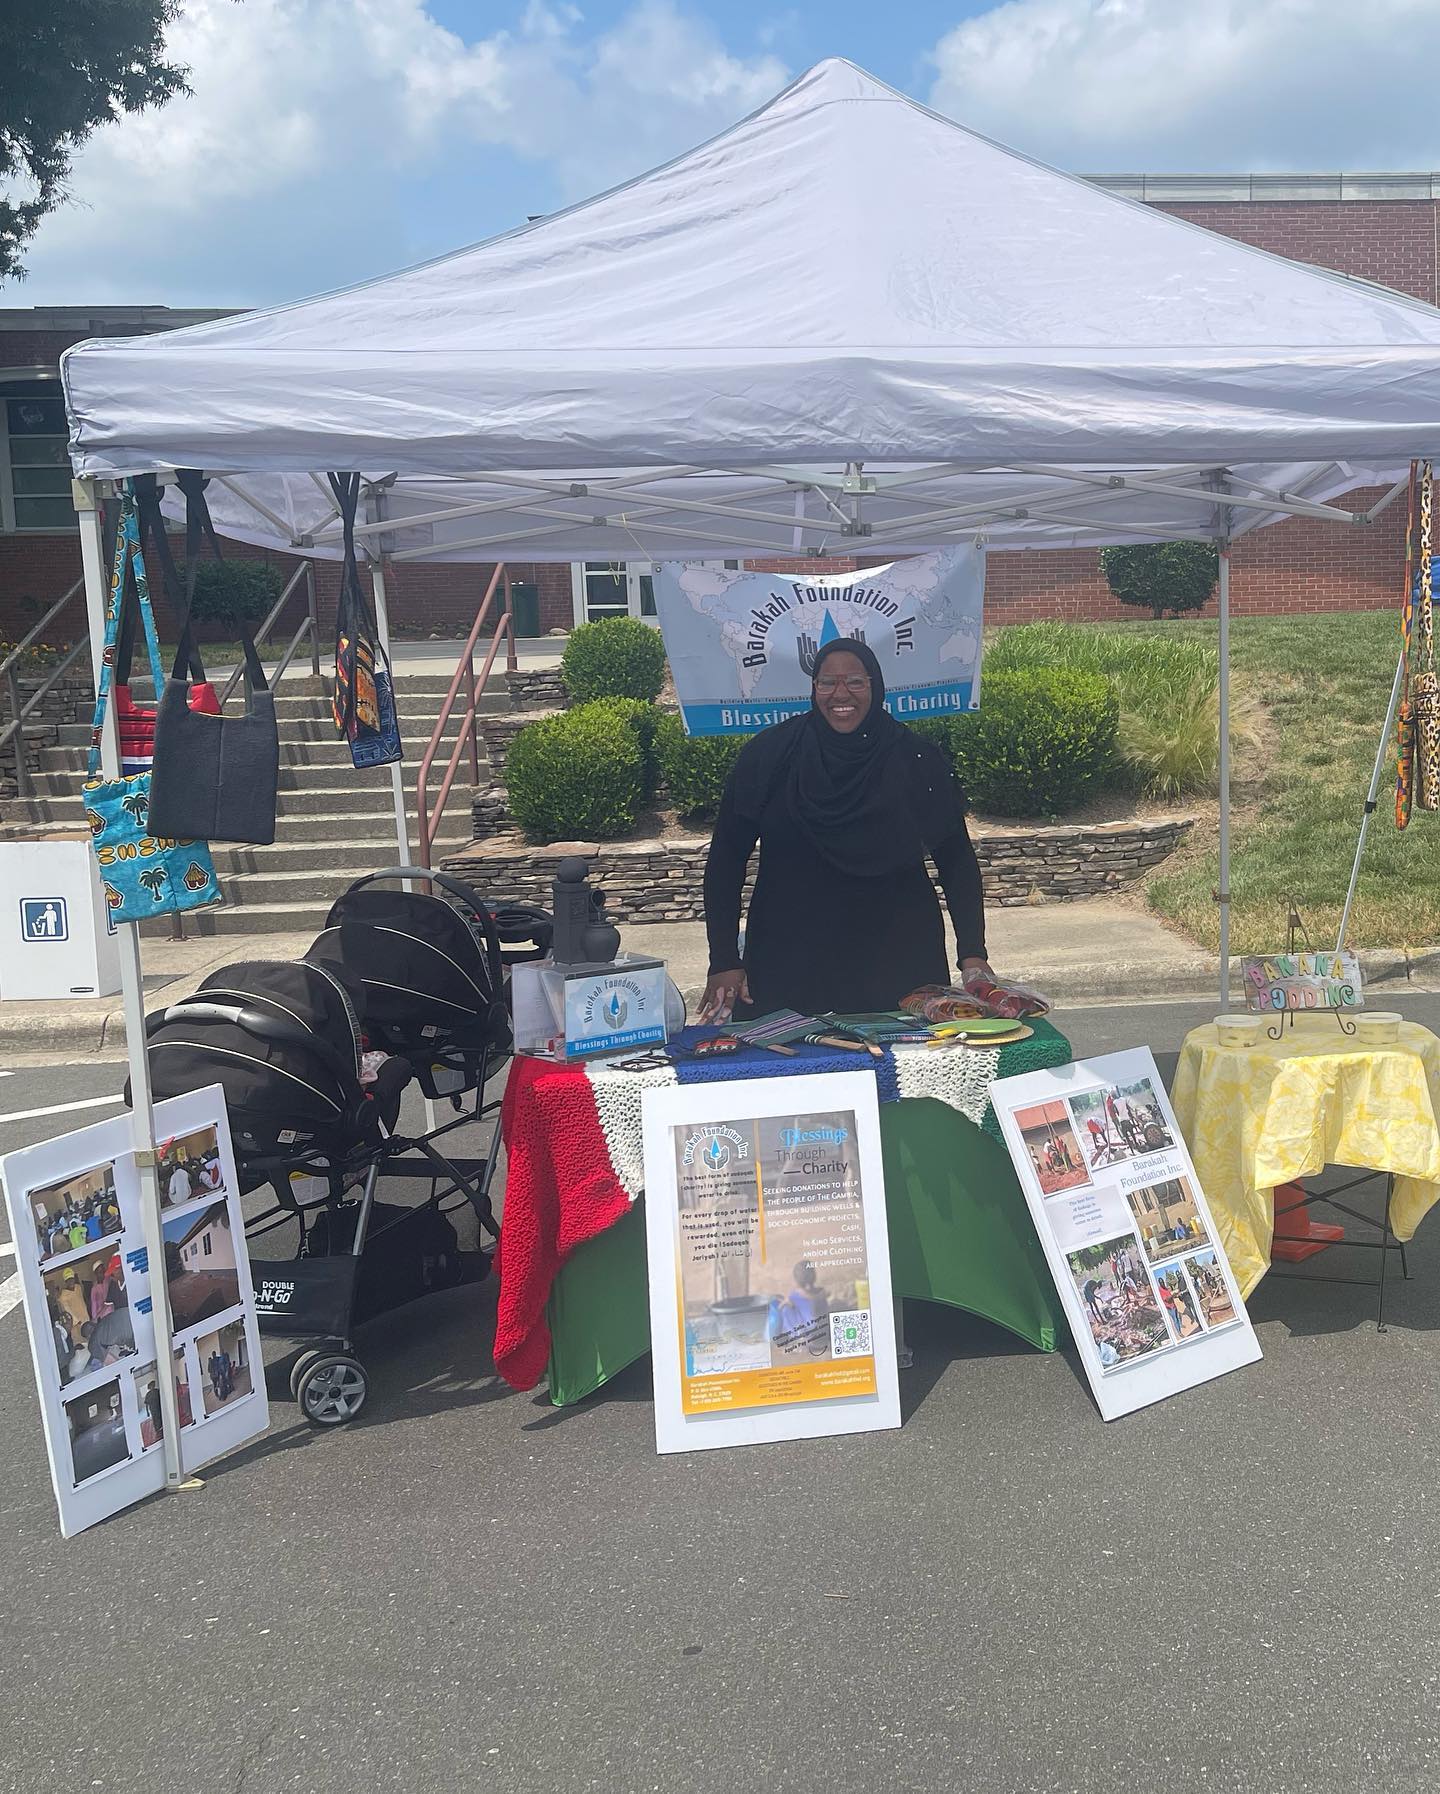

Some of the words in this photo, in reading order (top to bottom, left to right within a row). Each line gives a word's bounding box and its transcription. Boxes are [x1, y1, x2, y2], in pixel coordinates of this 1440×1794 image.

[742, 592, 791, 668] Barakah
[792, 583, 899, 618] Foundation
[894, 616, 916, 656] Inc.
[897, 693, 961, 713] Charity
[1249, 954, 1345, 989] BANANA
[584, 985, 602, 1024] Barakah
[604, 978, 642, 996] Foundation
[575, 1037, 609, 1051] Blessings
[610, 1034, 638, 1046] Through
[638, 1029, 662, 1040] Charity
[683, 1132, 702, 1165] Barakah
[702, 1125, 742, 1144] Foundation
[775, 1147, 826, 1162] Through
[802, 1161, 848, 1175] Charity
[1132, 1154, 1168, 1171] Barakah
[792, 1183, 830, 1192] DONATIONS
[1120, 1169, 1167, 1188] Foundation
[782, 1196, 806, 1204] PEOPLE
[262, 1281, 295, 1290] DOUBLE
